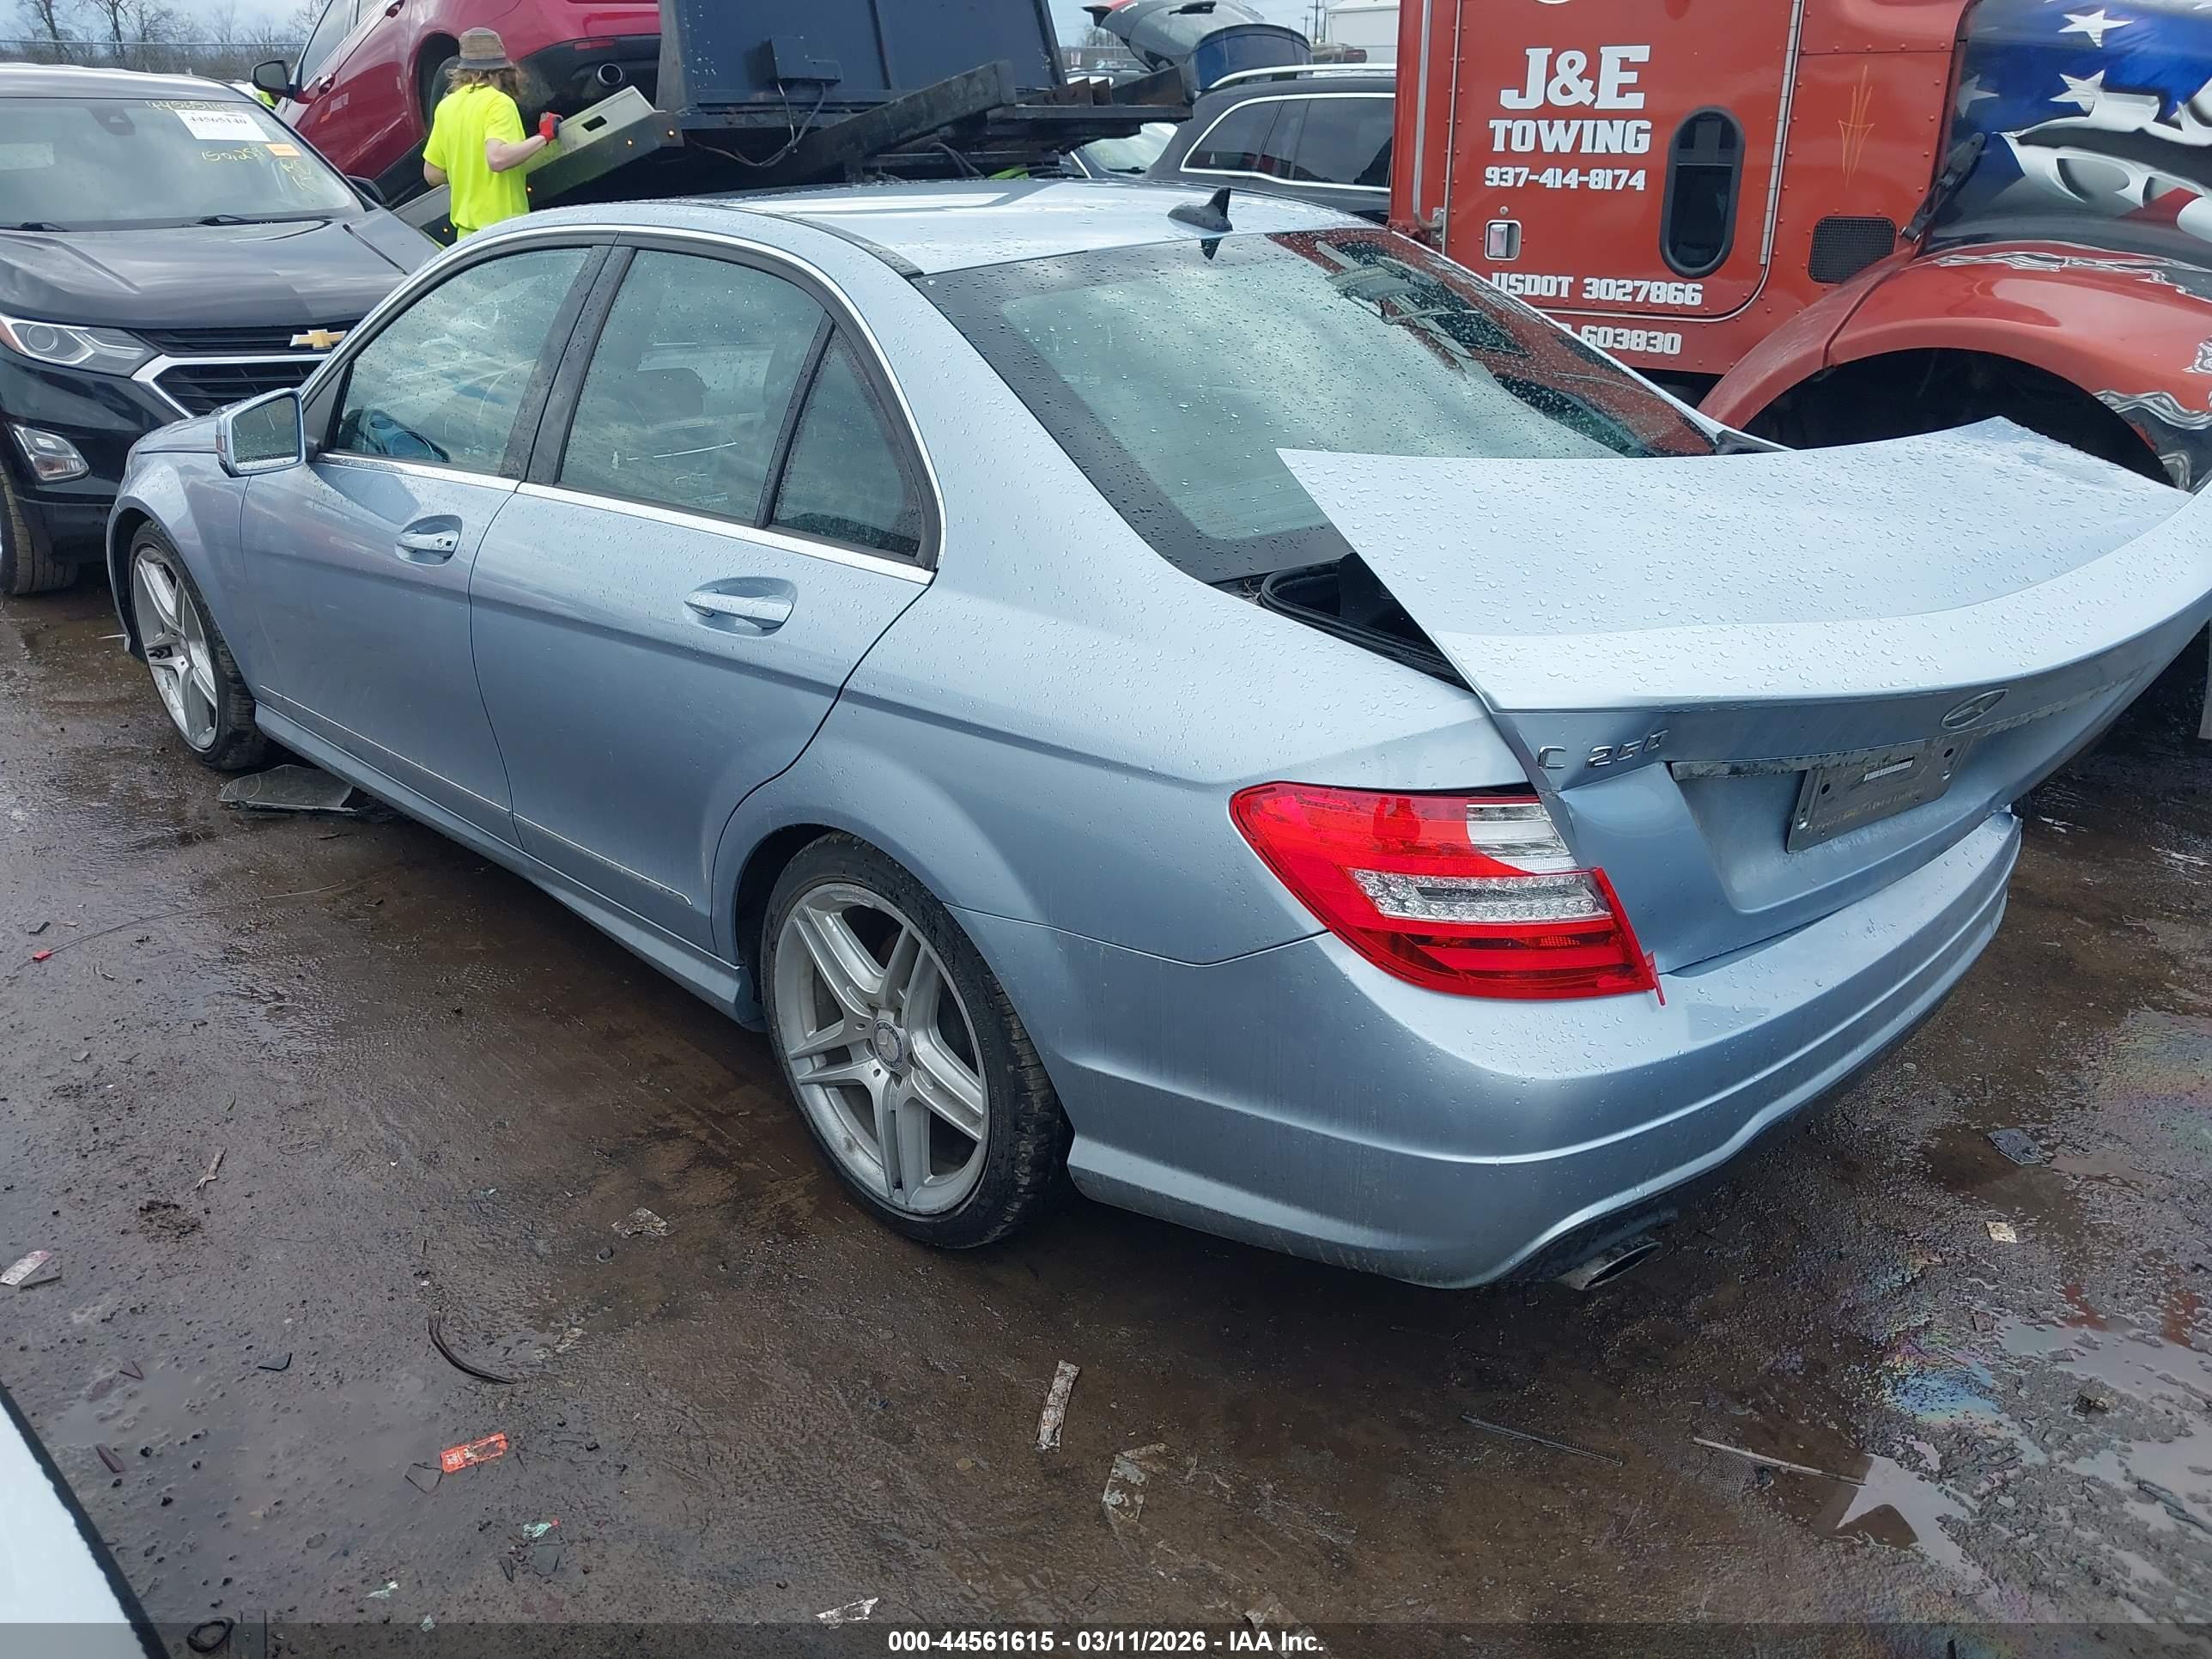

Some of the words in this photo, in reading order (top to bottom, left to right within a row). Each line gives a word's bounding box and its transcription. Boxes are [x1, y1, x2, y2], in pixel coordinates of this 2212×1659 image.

[1499, 45, 1650, 110] J&E
[1488, 119, 1652, 155] TOWING
[1485, 166, 1647, 191] 937-414-8174
[1492, 272, 1574, 298] USDOT
[1582, 277, 1704, 306] 3027866
[1580, 325, 1682, 356] 603830
[1538, 745, 1566, 769] C
